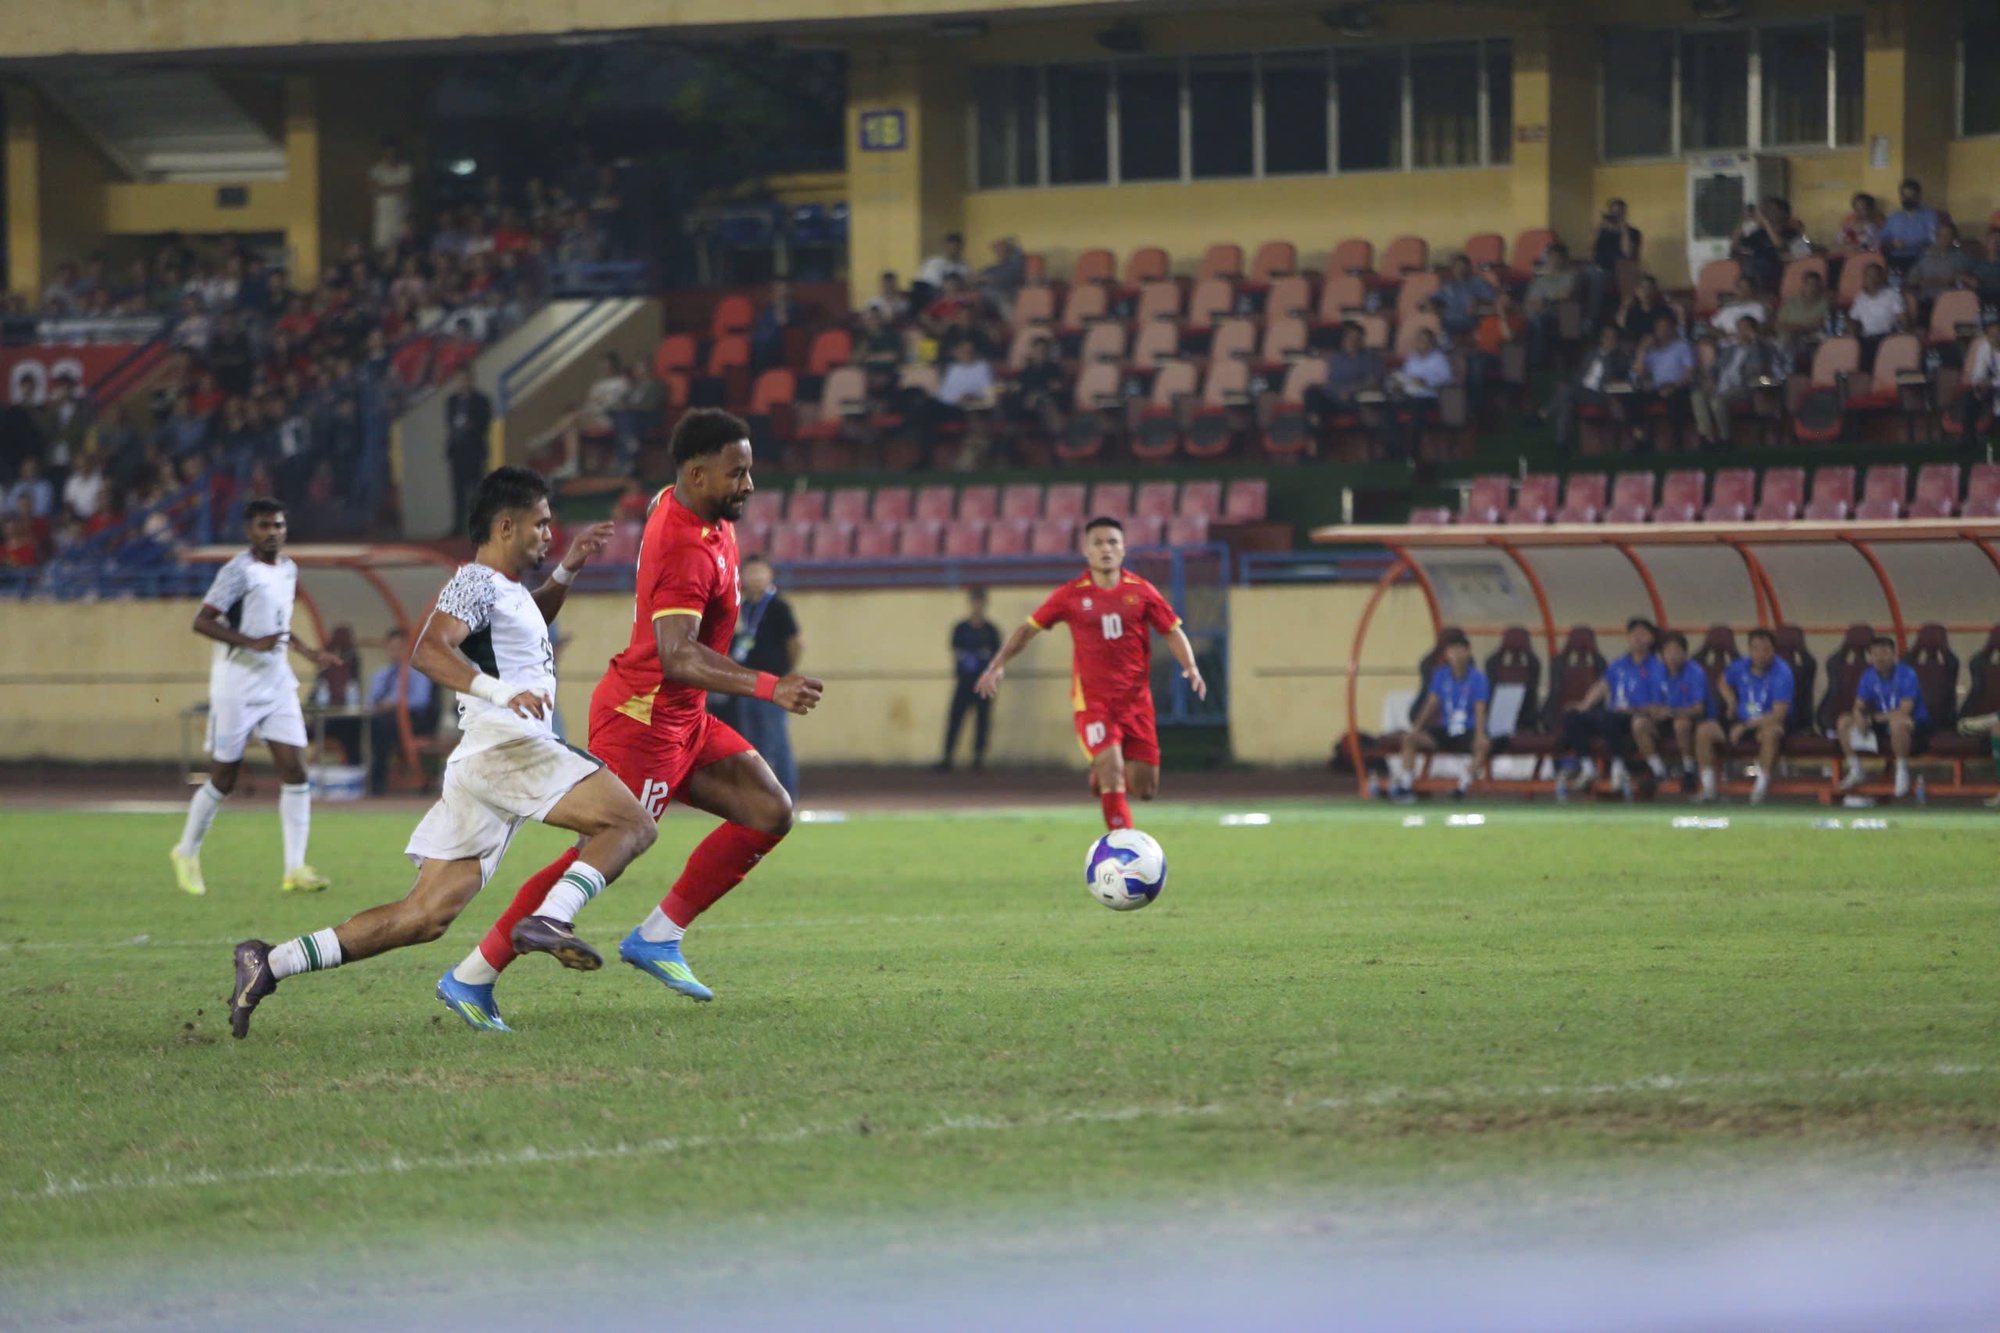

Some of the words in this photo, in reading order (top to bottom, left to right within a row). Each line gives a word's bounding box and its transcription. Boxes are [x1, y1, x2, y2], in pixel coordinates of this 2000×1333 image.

[1101, 613, 1123, 640] 10
[1086, 720, 1106, 747] 10
[640, 778, 669, 818] 12
